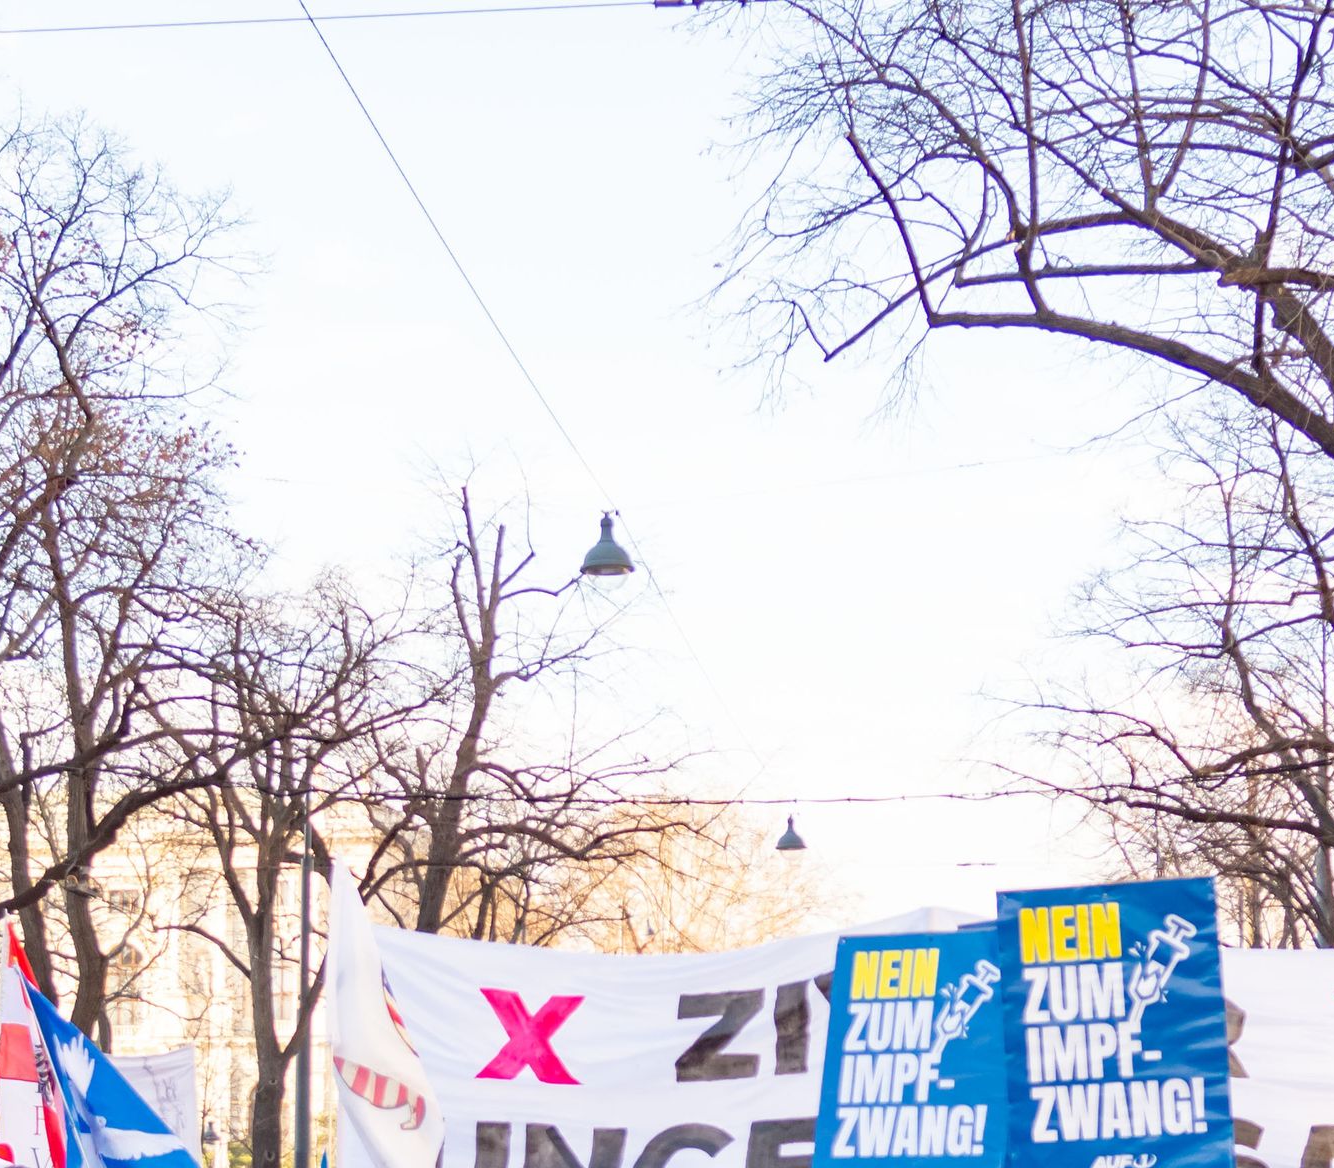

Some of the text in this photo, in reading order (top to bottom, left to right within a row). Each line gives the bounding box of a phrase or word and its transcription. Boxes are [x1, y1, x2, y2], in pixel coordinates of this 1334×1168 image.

[1019, 902, 1122, 964] NEIN
[850, 948, 940, 1000] NEIN
[1023, 962, 1125, 1024] ZUM
[843, 1000, 934, 1052] ZUM
[1026, 1021, 1162, 1084] IMPF-
[837, 1052, 955, 1104] IMPF-
[831, 1103, 988, 1158] ZWANG!
[1030, 1077, 1208, 1143] ZWANG!
